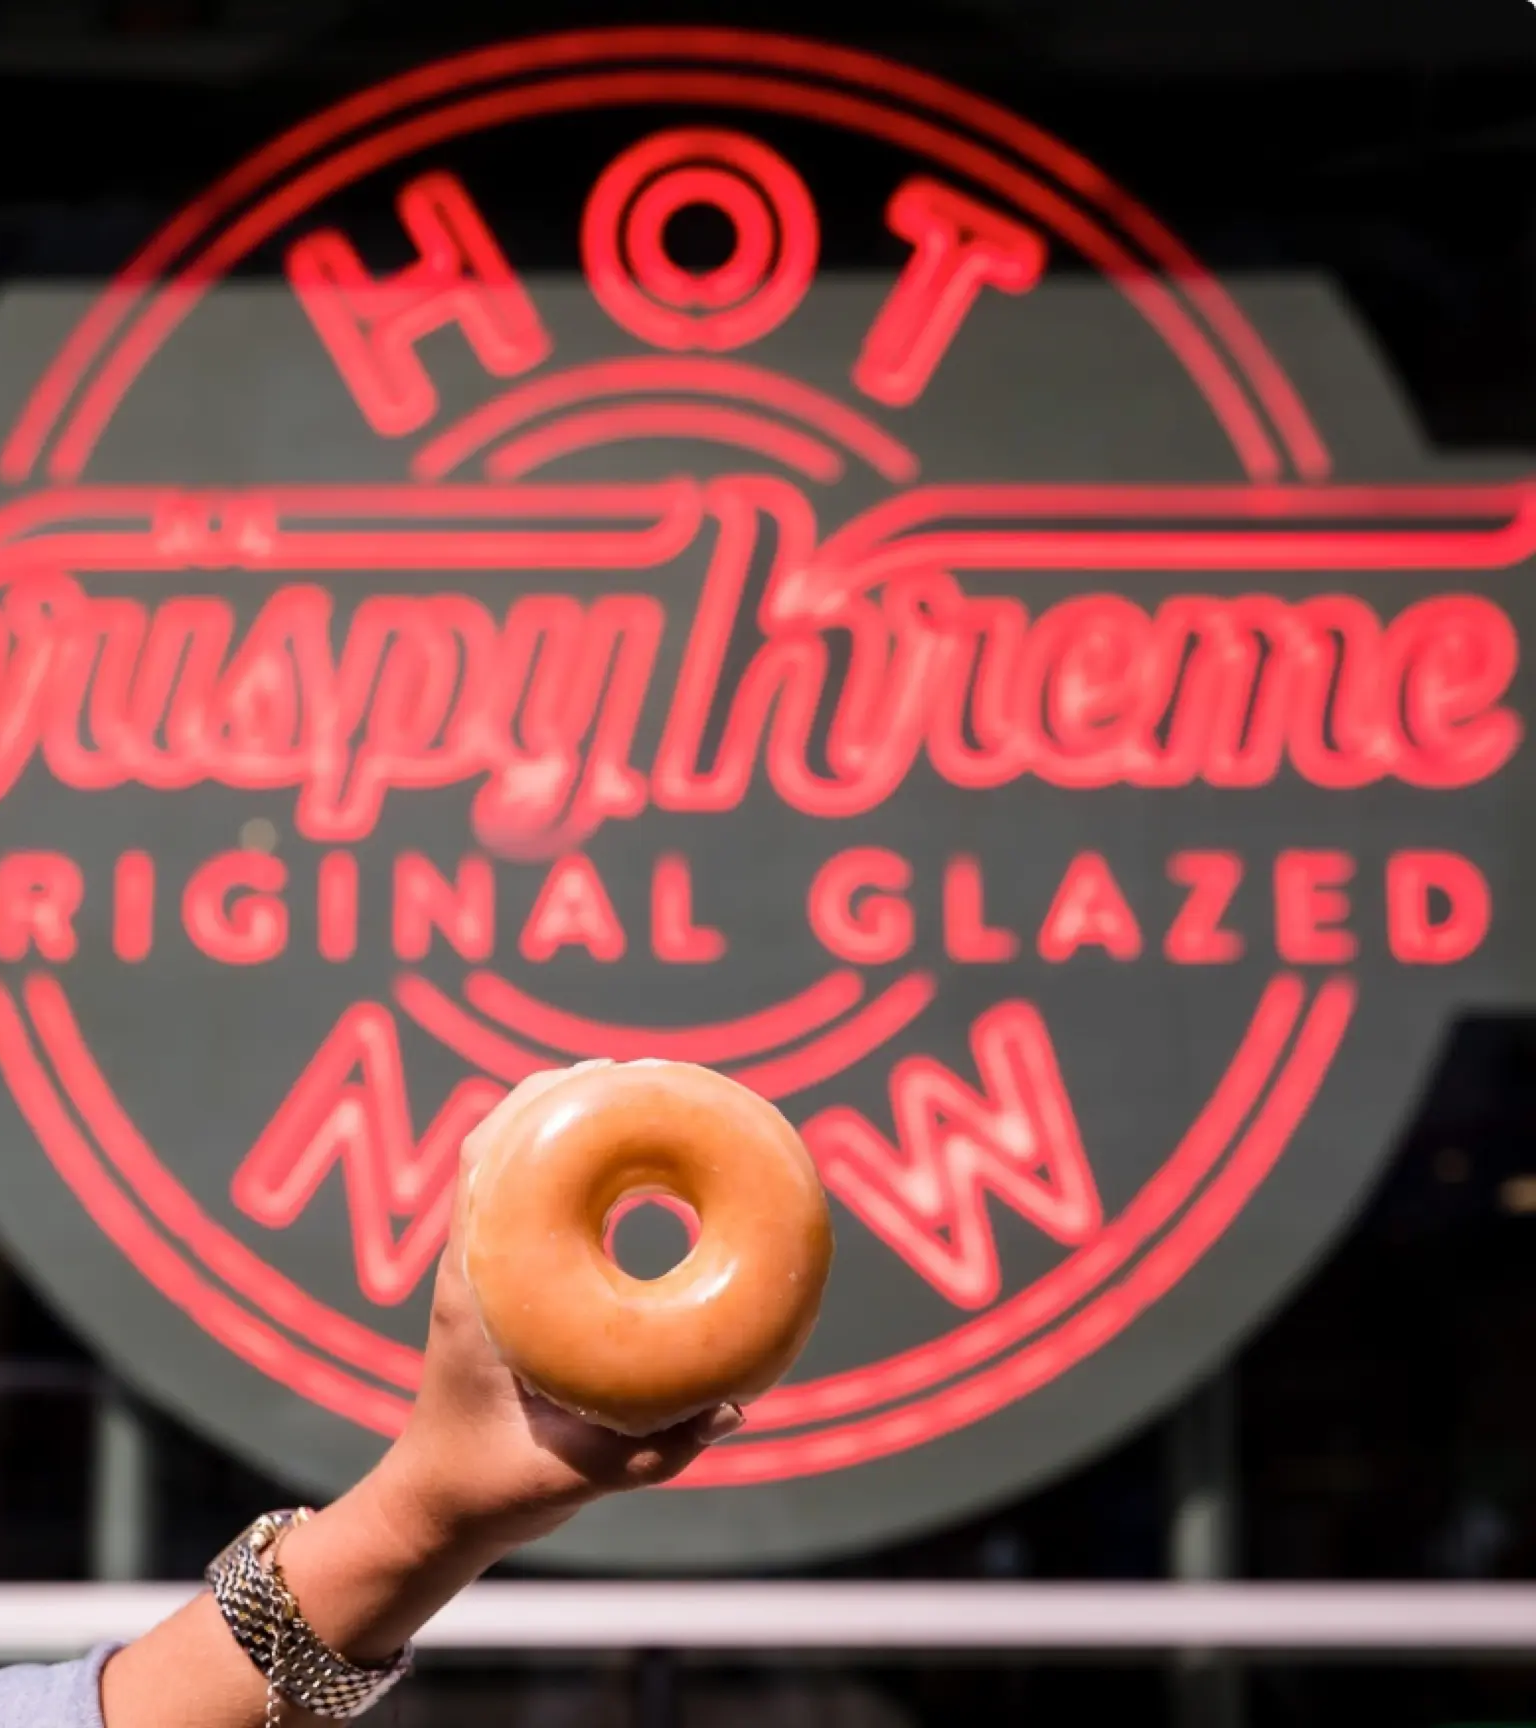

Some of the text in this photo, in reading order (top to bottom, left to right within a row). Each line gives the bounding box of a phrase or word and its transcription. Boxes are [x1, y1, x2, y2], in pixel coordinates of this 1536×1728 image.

[287, 128, 1047, 438] HOT
[652, 474, 1536, 816] Kreme
[808, 846, 1492, 964] GLAZED
[231, 1001, 1105, 1306] NW
